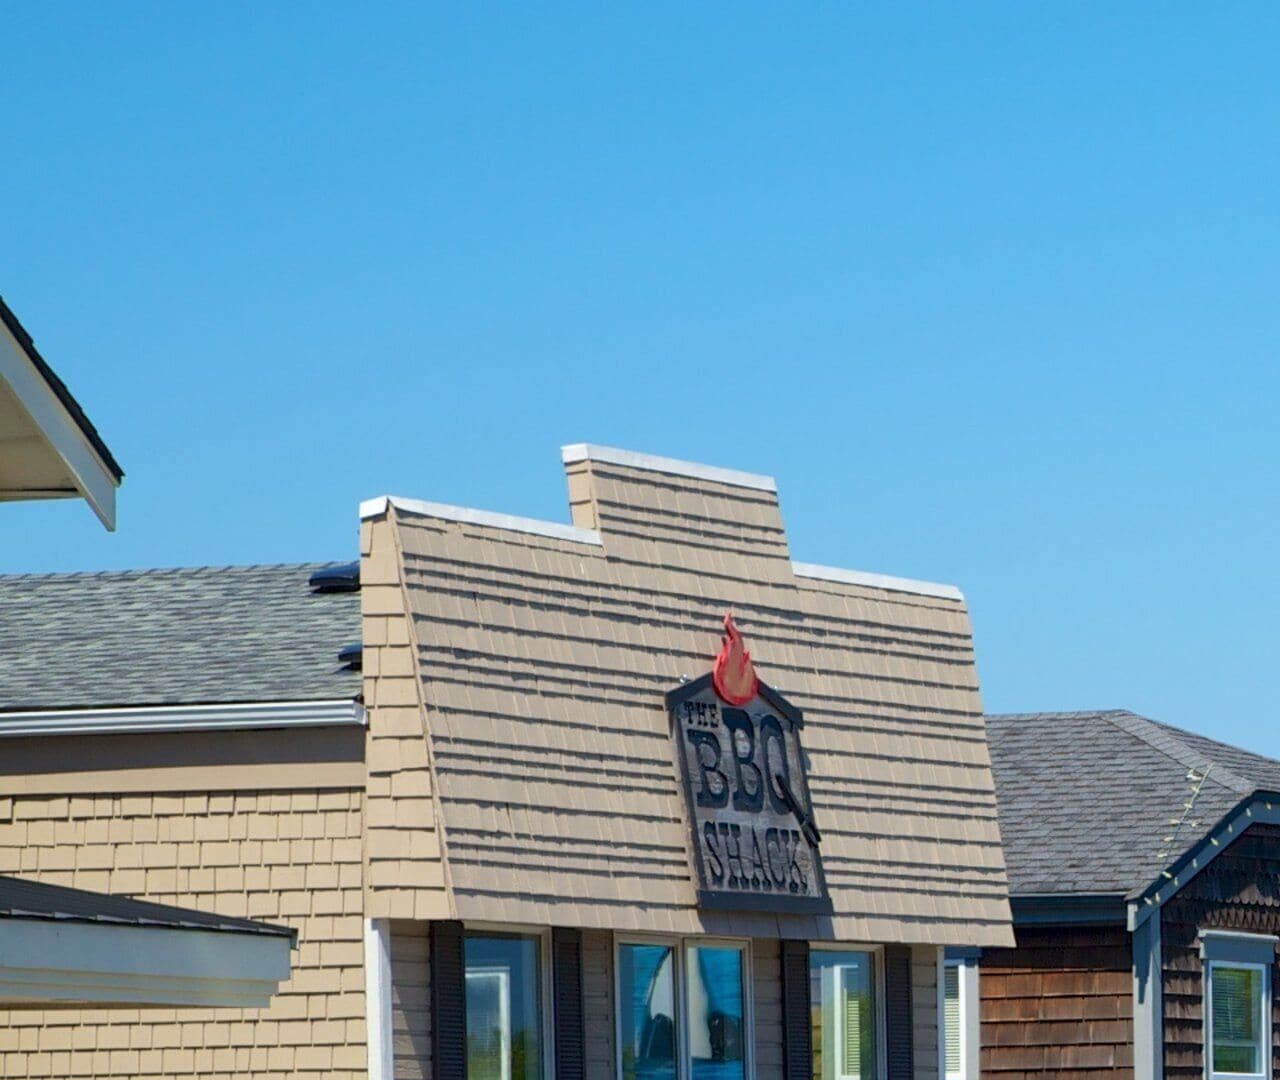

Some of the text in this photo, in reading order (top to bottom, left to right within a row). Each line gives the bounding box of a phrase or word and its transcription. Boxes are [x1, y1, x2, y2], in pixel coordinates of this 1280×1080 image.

[684, 702, 719, 728] THE
[687, 708, 812, 825] BBQ
[703, 821, 808, 893] SHACK
